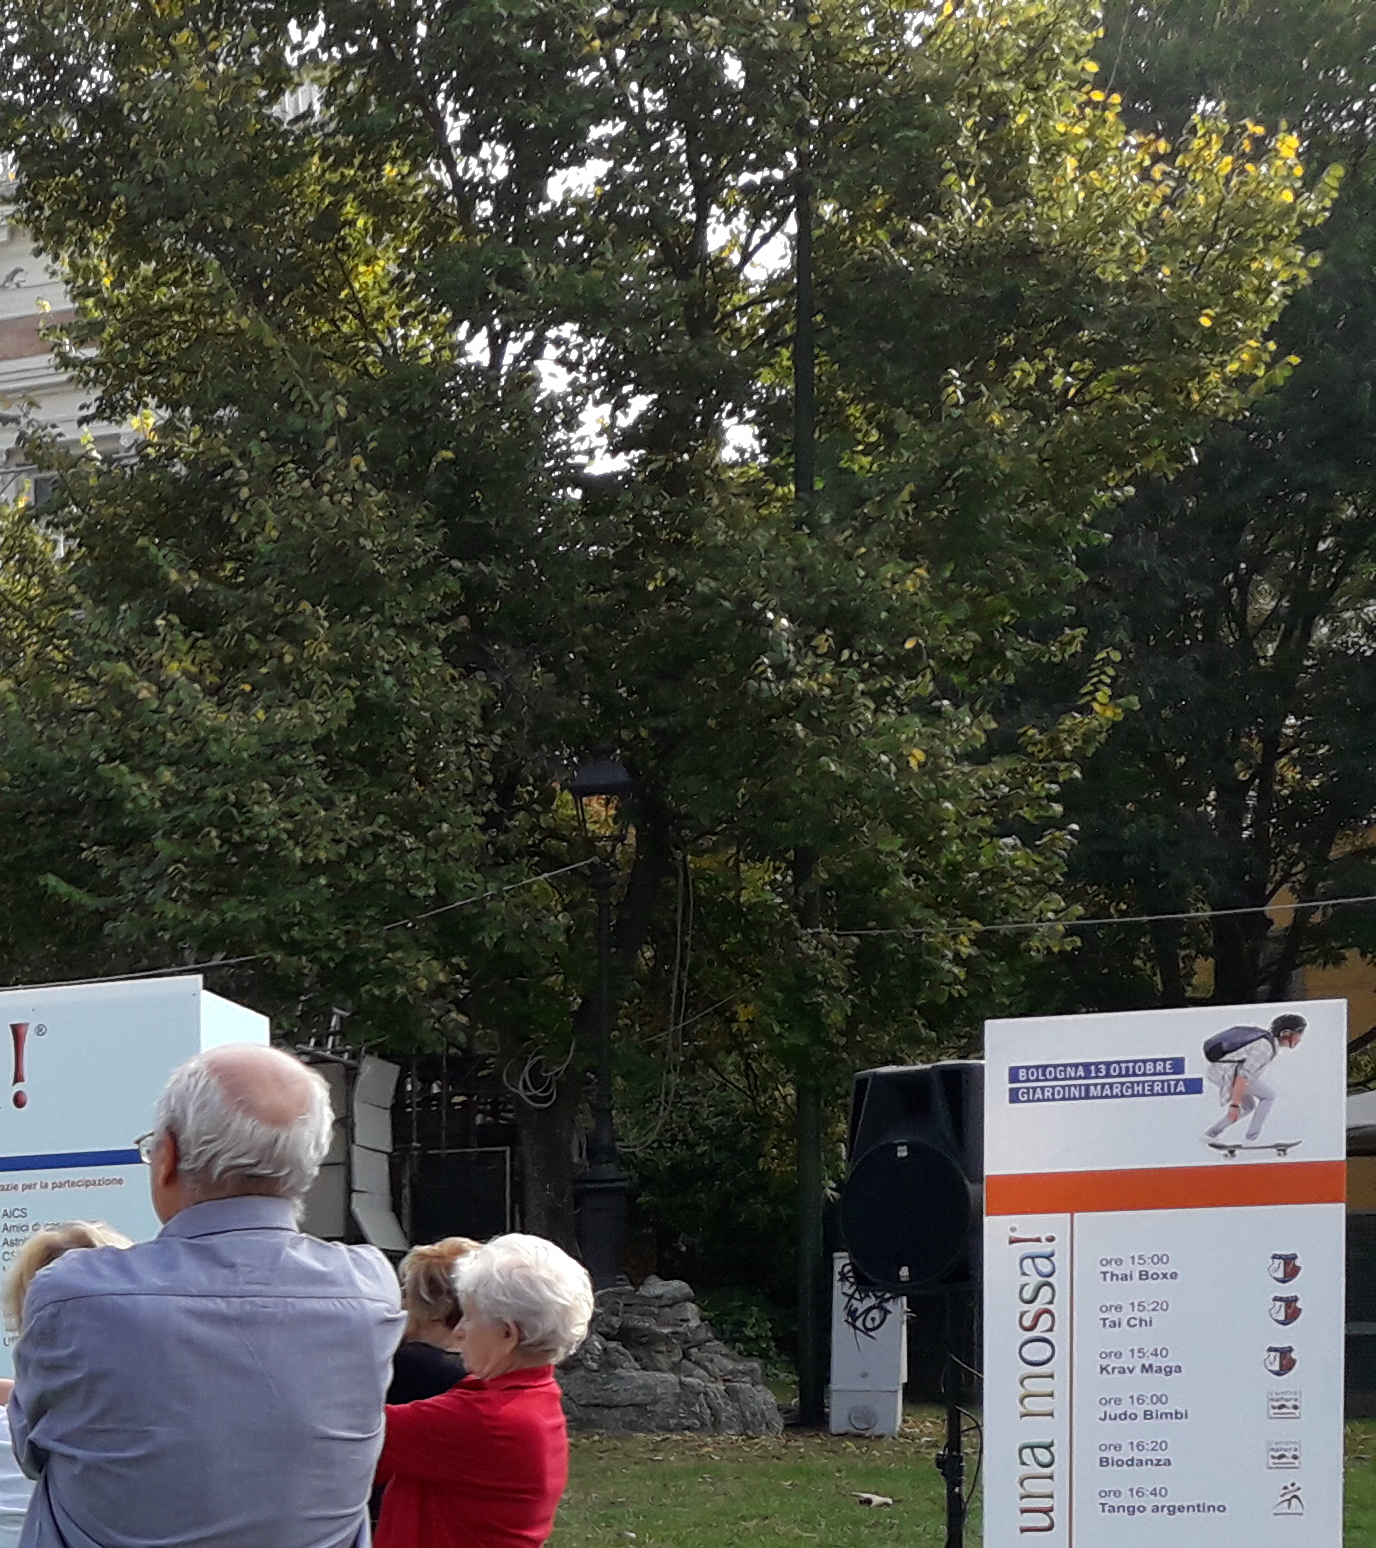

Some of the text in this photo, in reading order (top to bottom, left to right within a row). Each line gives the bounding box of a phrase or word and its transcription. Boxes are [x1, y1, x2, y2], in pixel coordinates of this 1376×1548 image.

[1018, 1060, 1174, 1081] BOLOGNA 13 OTTOBRE
[1018, 1080, 1186, 1101] GIARDINI MARGHERITA
[21, 1182, 38, 1194] per
[39, 1180, 48, 1190] la
[51, 1176, 124, 1192] partecipazione
[1099, 1253, 1170, 1267] ore 15:00
[1100, 1269, 1179, 1282] Thai Boxe
[1099, 1300, 1170, 1314] ore 15:20
[1099, 1316, 1154, 1329] Tai Chi
[1099, 1347, 1169, 1360] ore 15:40
[1099, 1363, 1183, 1377] Krav Maga
[1098, 1393, 1168, 1406] ore 16:00
[1099, 1408, 1188, 1421] Judo Bimbi
[1098, 1440, 1168, 1452] ore 16:20
[1099, 1456, 1172, 1468] Biodanza
[1017, 1438, 1056, 1535] una
[1098, 1486, 1168, 1499] ore 16:40
[1099, 1501, 1228, 1517] Tango argentino
